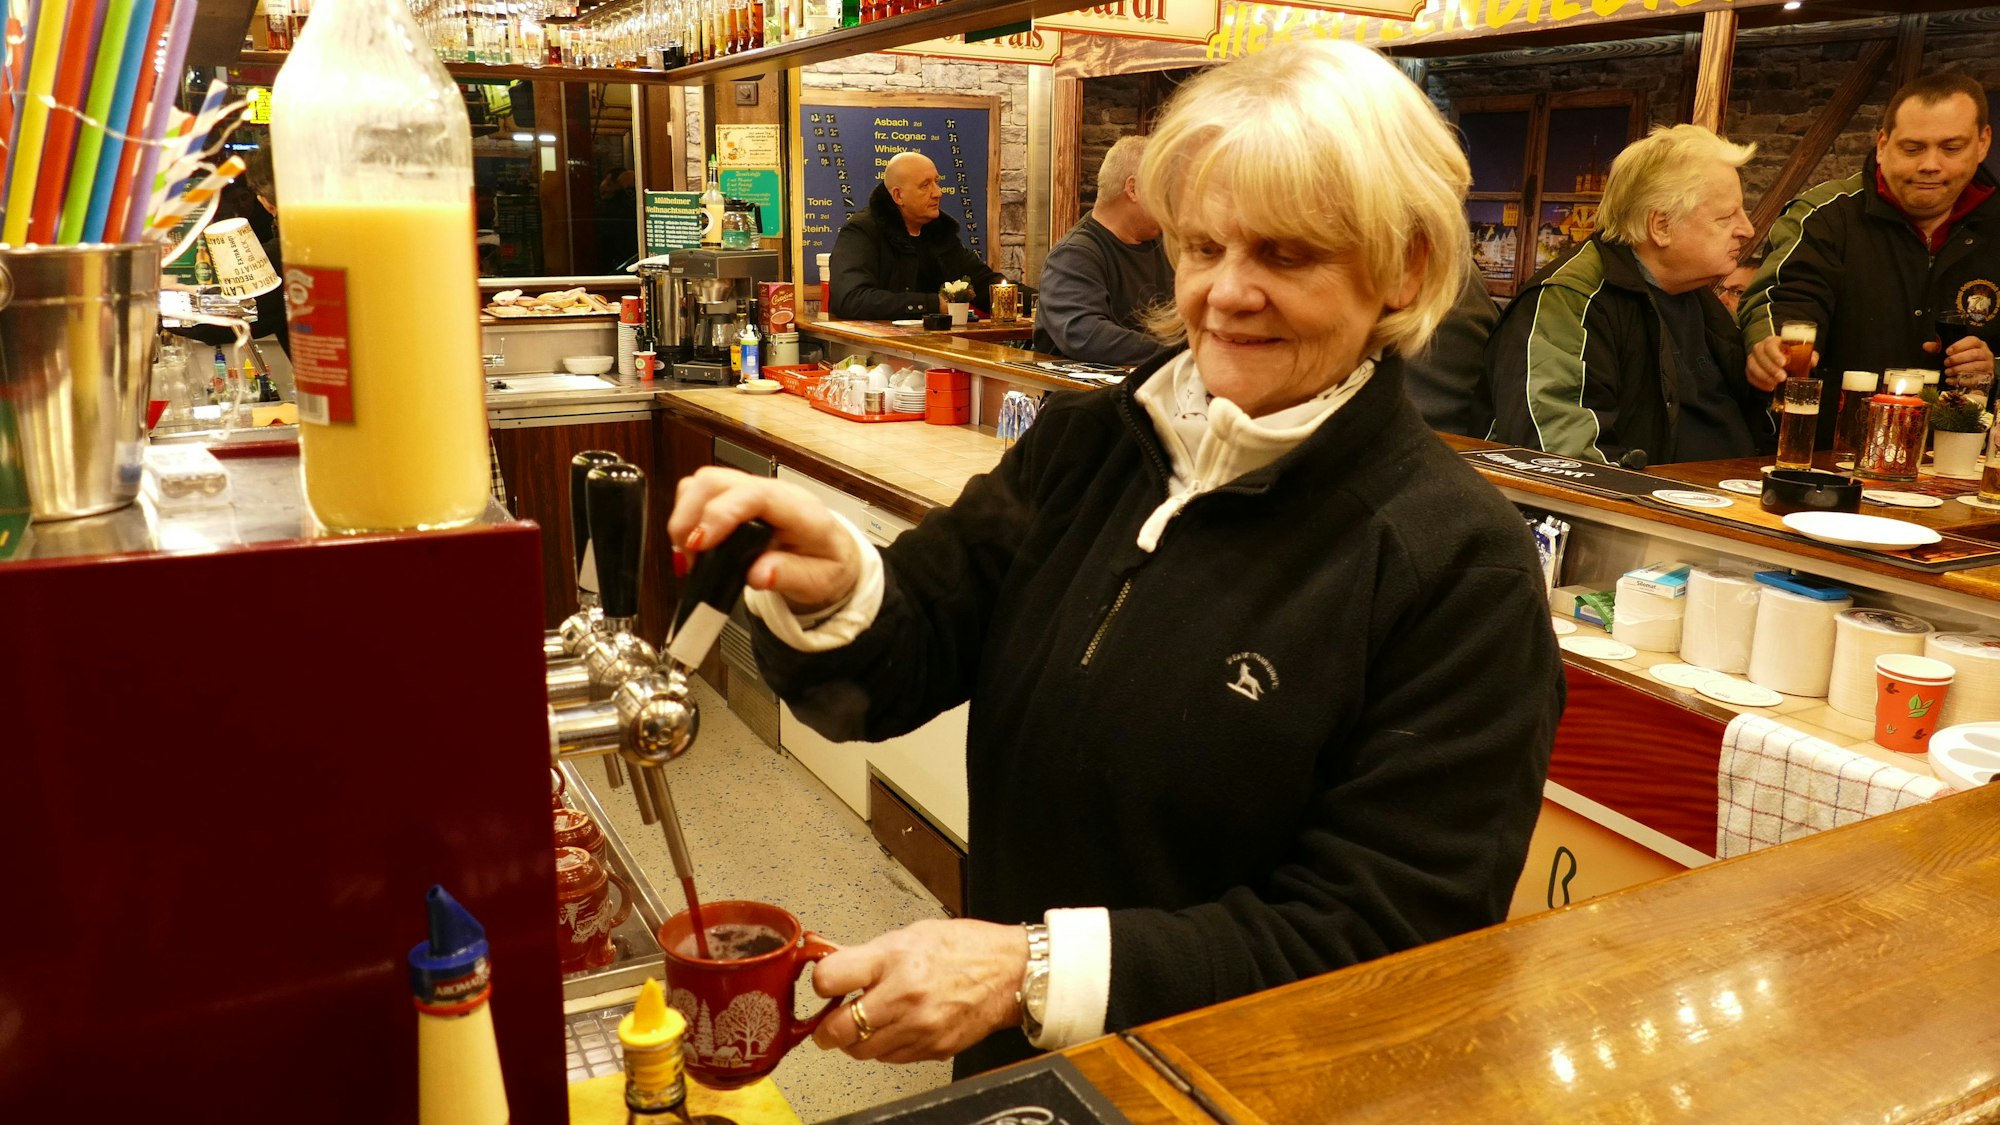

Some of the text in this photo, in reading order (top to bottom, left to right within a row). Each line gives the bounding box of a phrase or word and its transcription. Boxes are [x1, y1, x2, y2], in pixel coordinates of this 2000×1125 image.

[874, 118, 908, 127] Asbach
[874, 131, 888, 139] frz.
[891, 132, 926, 141] Cognac
[874, 145, 908, 154] Whisky
[807, 197, 833, 206] Tonic
